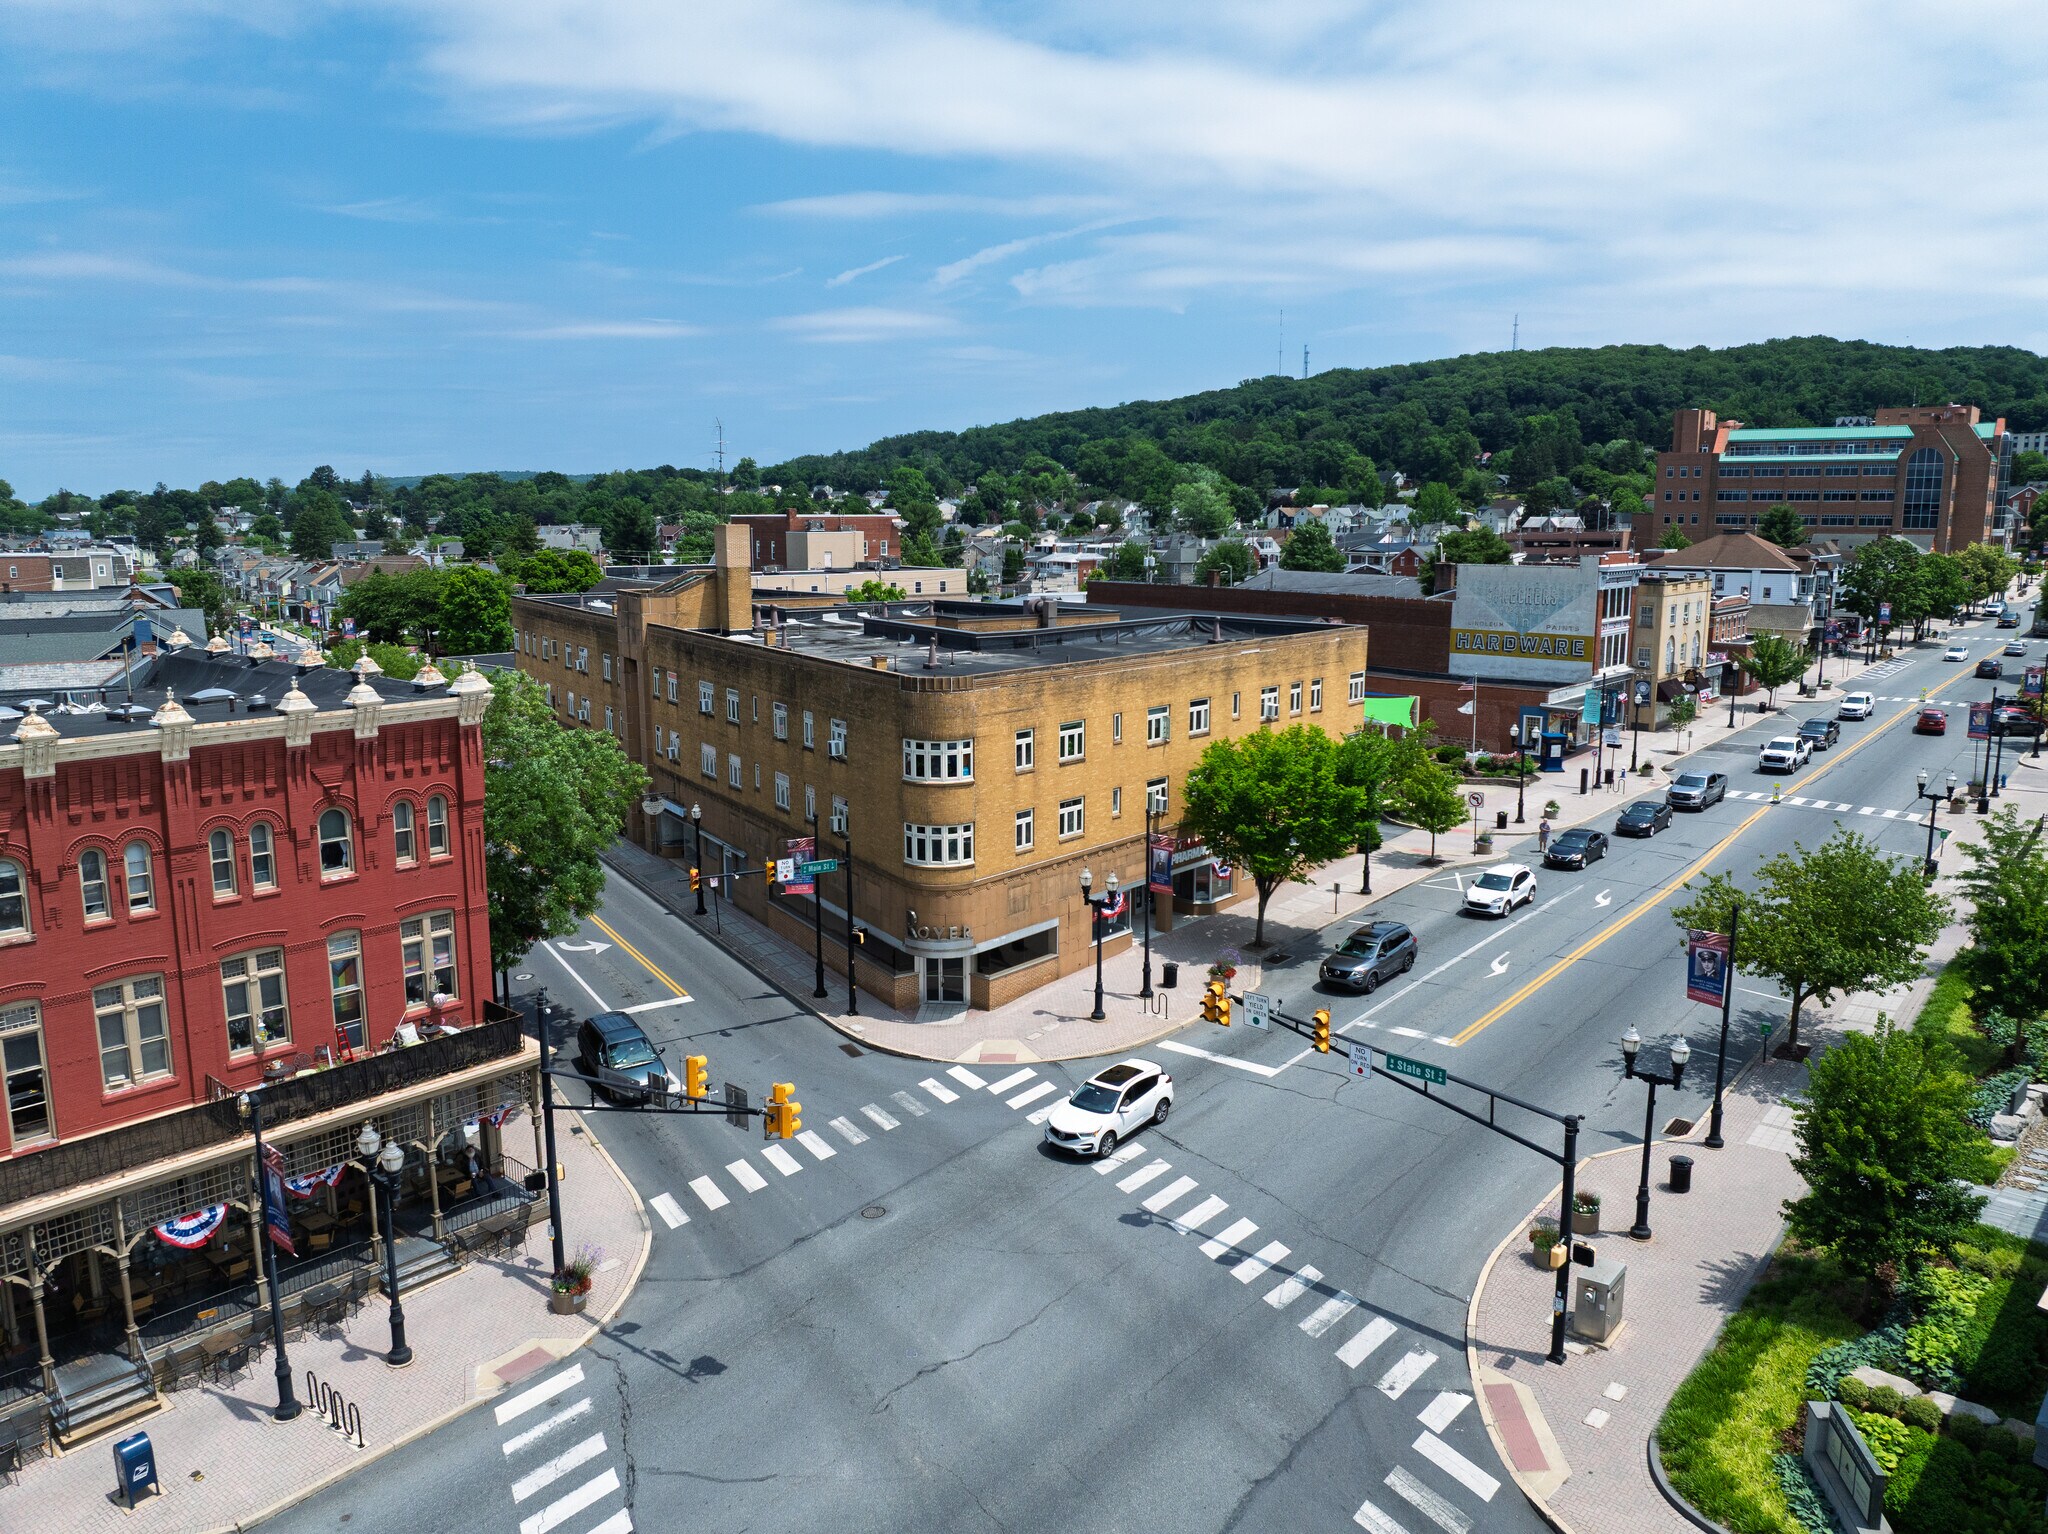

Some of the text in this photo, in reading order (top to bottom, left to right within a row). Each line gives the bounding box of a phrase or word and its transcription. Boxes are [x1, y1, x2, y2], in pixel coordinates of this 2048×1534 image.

[1546, 624, 1580, 632] PAINTS
[1457, 632, 1584, 656] HARDWARE
[905, 910, 972, 939] ROYER
[1249, 1001, 1263, 1010] YIELD
[1397, 1060, 1421, 1076] State
[1425, 1068, 1434, 1079] St
